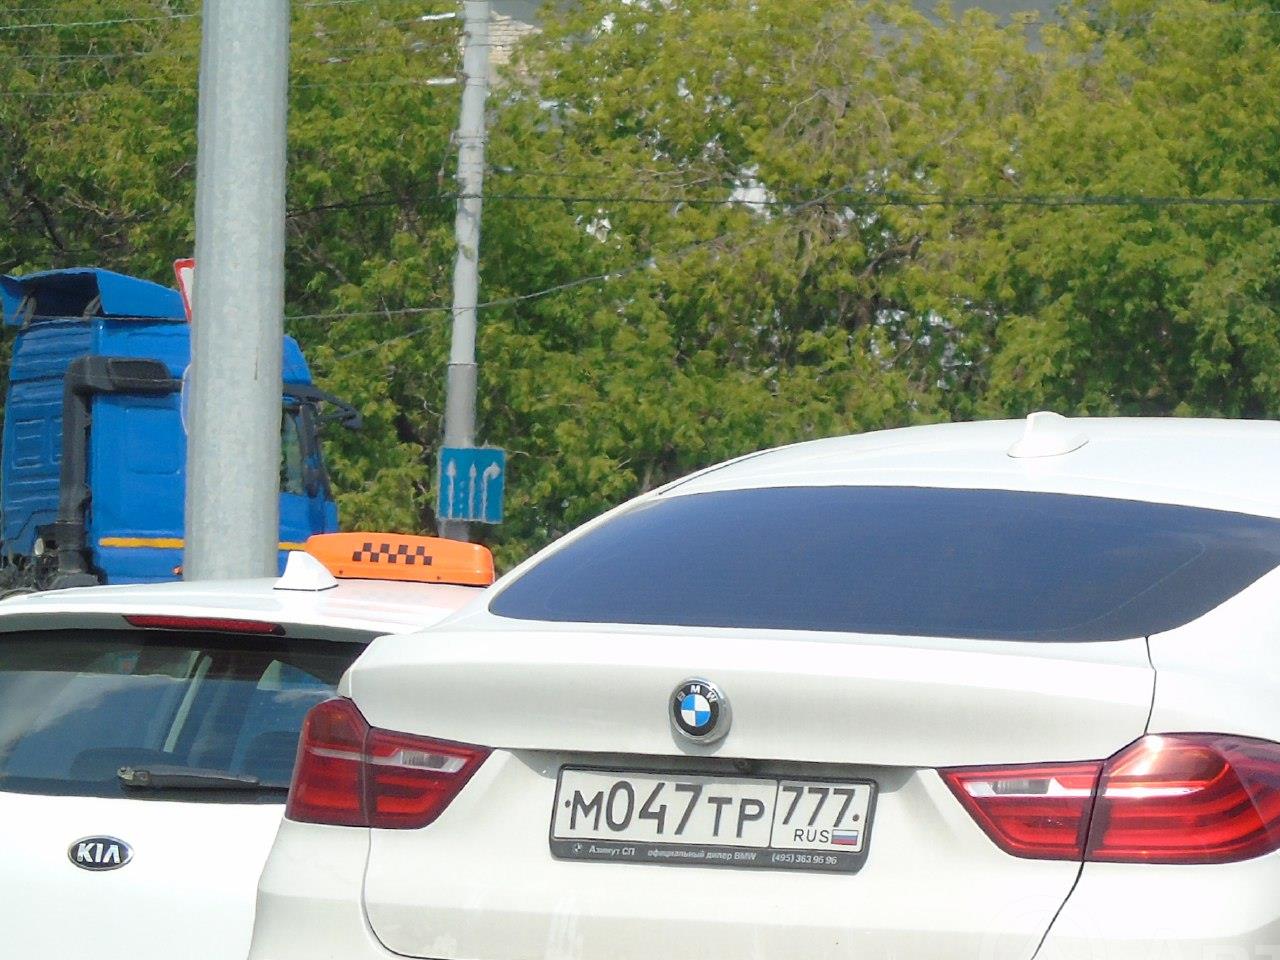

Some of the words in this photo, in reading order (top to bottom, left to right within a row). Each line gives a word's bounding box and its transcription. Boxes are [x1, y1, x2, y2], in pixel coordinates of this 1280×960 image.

[676, 684, 719, 703] BMW
[569, 780, 766, 838] М047ТР
[782, 787, 855, 828] 777
[793, 828, 829, 844] RUS
[76, 842, 121, 864] KIA
[621, 846, 636, 856] СП
[647, 847, 706, 858] официальный
[705, 851, 733, 861] дилер
[733, 851, 757, 861] BMW
[771, 852, 795, 863] (495)
